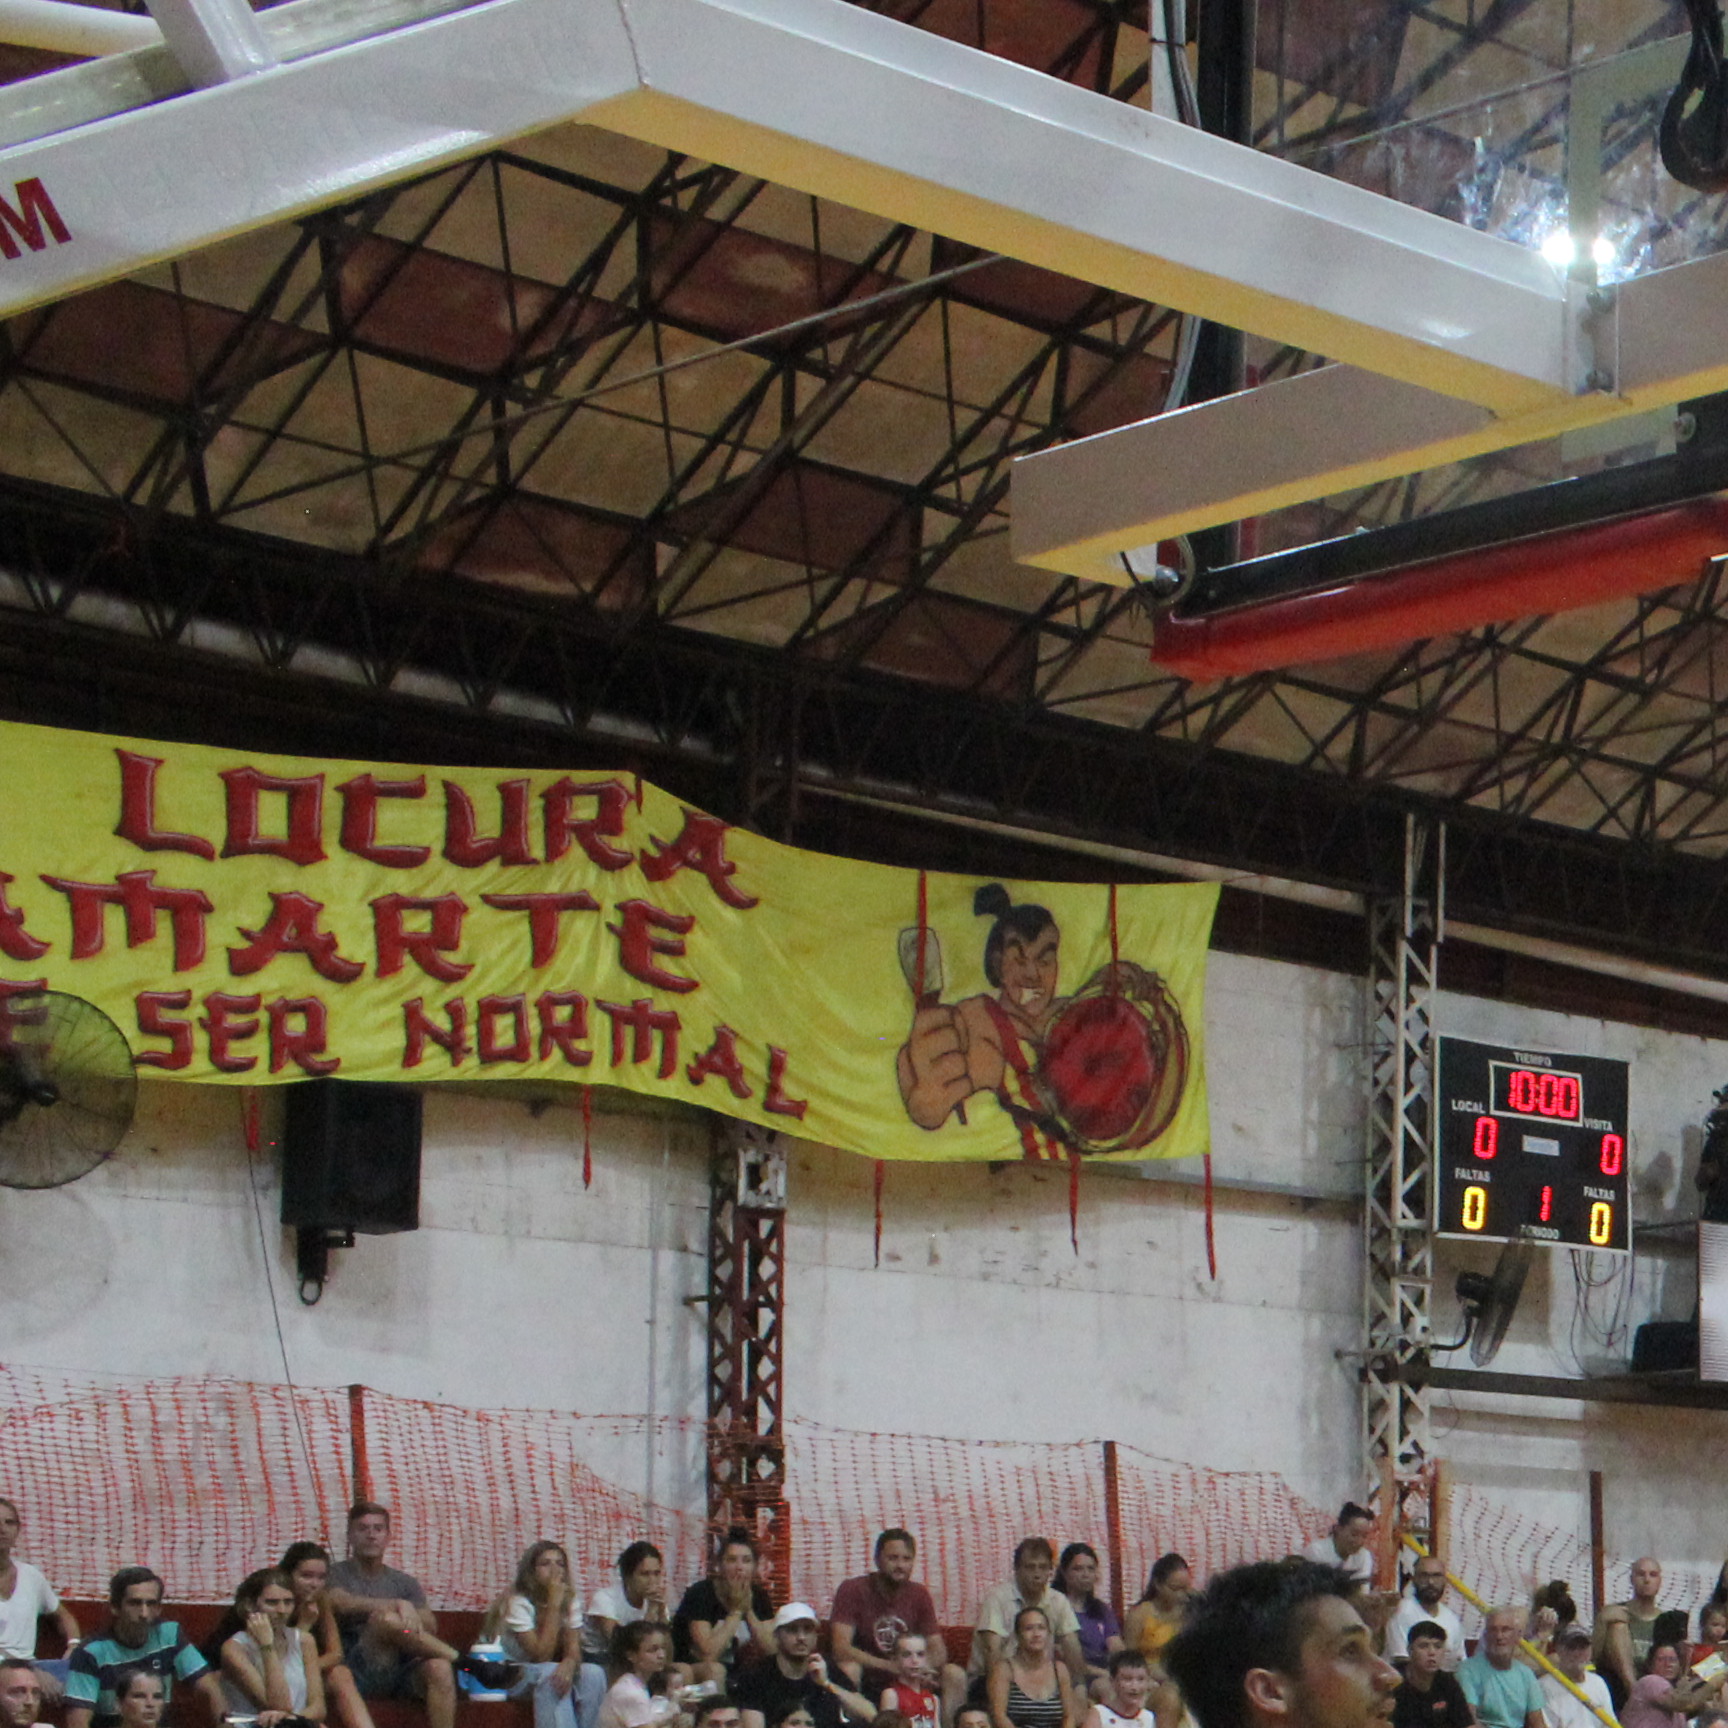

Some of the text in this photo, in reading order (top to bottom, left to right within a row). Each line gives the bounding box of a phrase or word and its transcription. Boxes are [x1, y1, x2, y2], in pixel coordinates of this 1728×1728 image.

[114, 747, 759, 910] LOCURA
[132, 989, 341, 1078] SER
[401, 998, 808, 1120] NORMAL
[1513, 1051, 1552, 1067] TIEMPO
[1451, 1098, 1486, 1115] LOCAL
[1583, 1117, 1613, 1132] VISITA
[1473, 1115, 1499, 1160] 0
[1600, 1133, 1623, 1175] 0
[1454, 1167, 1491, 1183] FALTAS
[1583, 1186, 1616, 1201] FALTAS
[1462, 1186, 1486, 1230] 0
[1539, 1185, 1552, 1222] 1
[1589, 1202, 1611, 1246] 0
